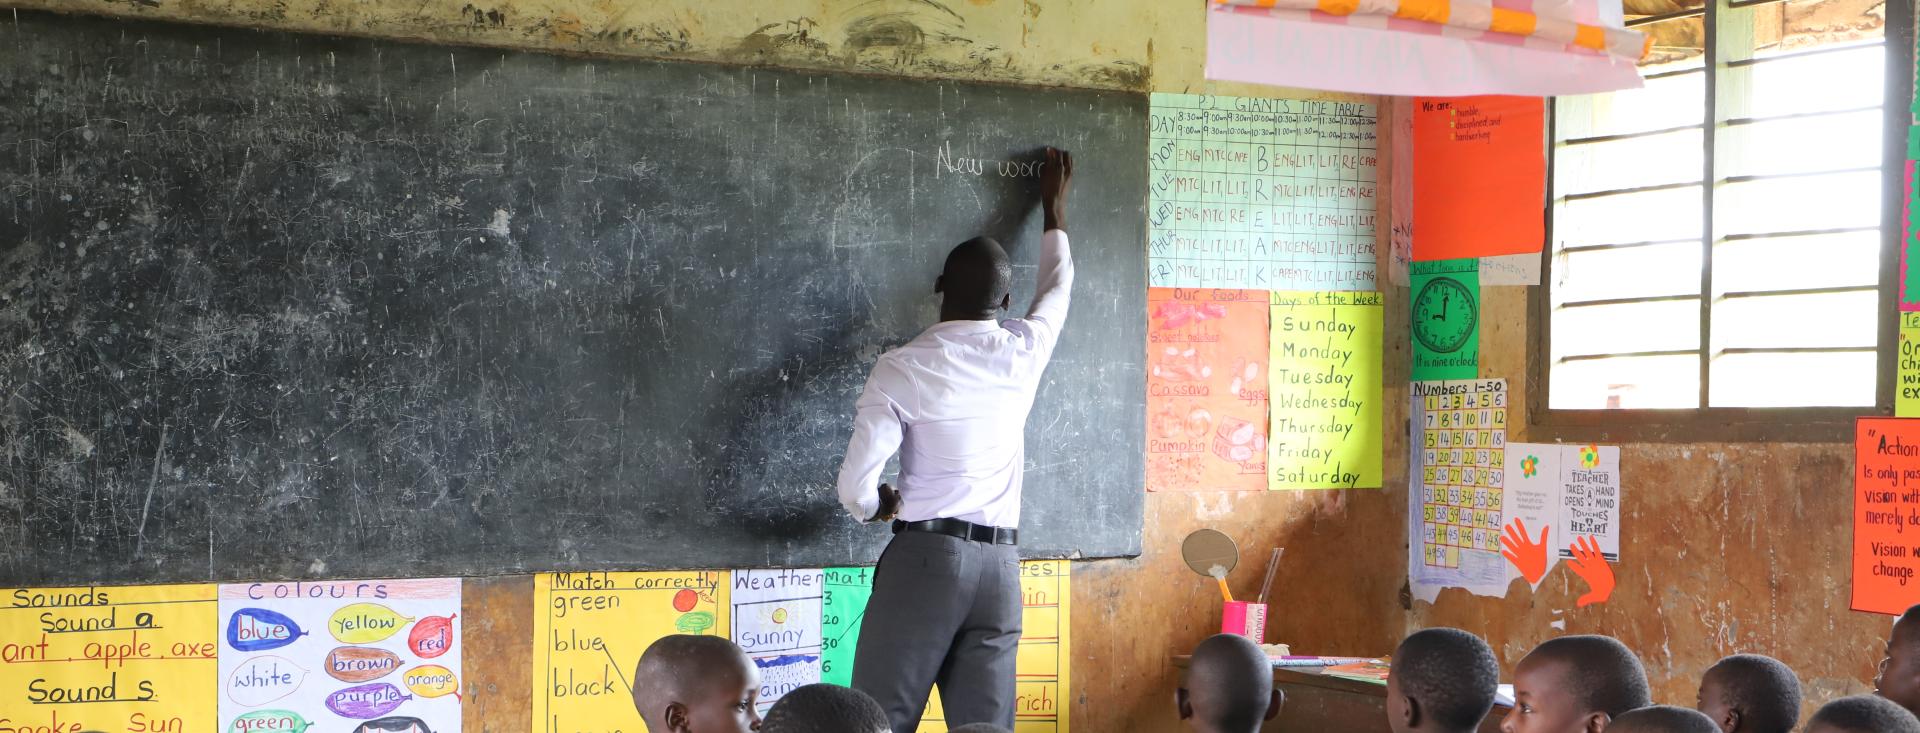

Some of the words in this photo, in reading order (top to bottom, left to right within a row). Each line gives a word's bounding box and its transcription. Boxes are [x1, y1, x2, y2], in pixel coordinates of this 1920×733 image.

[1235, 97, 1289, 113] GIANTS
[1300, 101, 1327, 115] TIME
[1334, 103, 1365, 117] TABLE
[1422, 101, 1433, 112] We
[1152, 115, 1175, 133] DAY
[937, 140, 982, 179] New
[1151, 140, 1175, 170] MON
[1178, 149, 1200, 162] ENG
[1205, 149, 1225, 163] MTC
[1274, 153, 1295, 168] ENG
[1342, 155, 1356, 169] RE
[1151, 170, 1174, 198] TUE
[1177, 177, 1199, 192] MTC
[1274, 184, 1292, 197] MTC
[1340, 186, 1356, 197] ENG
[1359, 187, 1374, 199] RE
[1150, 201, 1173, 228] WED
[1177, 207, 1198, 220] ENG
[1203, 208, 1224, 223] MTC
[1231, 208, 1245, 223] RE
[1318, 214, 1336, 227] ENG
[1150, 260, 1174, 286] FRI
[1174, 288, 1200, 300] Our
[1274, 291, 1301, 311] Days
[1309, 291, 1319, 304] of
[1325, 291, 1346, 305] the
[1283, 307, 1356, 340] Sunday
[1283, 336, 1352, 368] Monday
[1416, 353, 1422, 367] It
[1432, 357, 1448, 367] nine
[1280, 365, 1353, 389] Tuesday
[1150, 384, 1209, 396] Cassava
[1239, 388, 1265, 406] eggs
[1414, 381, 1468, 396] Numbers
[1280, 390, 1363, 416] Wednesday
[1429, 398, 1433, 409] 1
[1442, 397, 1450, 409] 2
[1453, 396, 1461, 409] 3
[1466, 395, 1475, 408] 4
[1482, 394, 1490, 407] 5
[1494, 393, 1501, 406] 6
[1280, 415, 1353, 441] Thursday
[1427, 415, 1434, 427] 7
[1441, 414, 1449, 427] 8
[1453, 413, 1460, 426] 9
[1466, 413, 1475, 425] 10
[1480, 411, 1487, 424] 11
[1495, 411, 1504, 424] 12
[1151, 439, 1206, 453] Pumpkin
[1425, 433, 1435, 447] 13
[1440, 432, 1449, 446] 14
[1452, 432, 1462, 445] 15
[1465, 432, 1474, 446] 16
[1479, 432, 1489, 445] 17
[1492, 432, 1502, 445] 18
[1278, 437, 1332, 464] Friday
[1425, 452, 1434, 464] 19
[1438, 451, 1449, 463] 20
[1451, 451, 1460, 463] 21
[1464, 451, 1474, 464] 22
[1477, 451, 1488, 463] 23
[1491, 452, 1502, 467] 24
[1277, 461, 1360, 488] Saturday
[1436, 469, 1447, 481] 26
[1450, 469, 1460, 482] 27
[1463, 469, 1474, 483] 28
[1490, 471, 1501, 485] 30
[1572, 472, 1609, 485] TEACHER
[1864, 464, 1872, 478] Is
[1877, 464, 1898, 487] only
[1565, 484, 1584, 495] TAKES
[1595, 486, 1615, 497] HAND
[1565, 496, 1584, 507] OPENS
[1595, 499, 1615, 508] MIND
[1571, 508, 1608, 521] TOUCHES
[1866, 507, 1903, 534] merely
[1571, 520, 1608, 534] HEART
[1872, 542, 1906, 557] Vision
[555, 572, 615, 590] Match
[634, 571, 718, 596] correctly
[735, 569, 824, 590] Weather
[1873, 560, 1914, 586] change
[13, 587, 109, 608] Sounds
[554, 595, 620, 618] green
[823, 591, 833, 605] 3
[40, 607, 116, 632] Sound
[823, 615, 839, 625] 20
[238, 614, 289, 640] blue
[419, 628, 445, 650] red
[555, 628, 605, 651] blue
[742, 629, 805, 650] Sunny
[171, 642, 217, 657] axe
[822, 637, 838, 650] 30
[234, 663, 292, 688] white
[333, 654, 396, 673] brown
[407, 672, 453, 690] orange
[822, 660, 832, 673] 6
[28, 672, 117, 703] Sound
[553, 664, 615, 699] black
[335, 685, 397, 708] purple
[1015, 685, 1052, 712] rich
[235, 716, 294, 733] green
